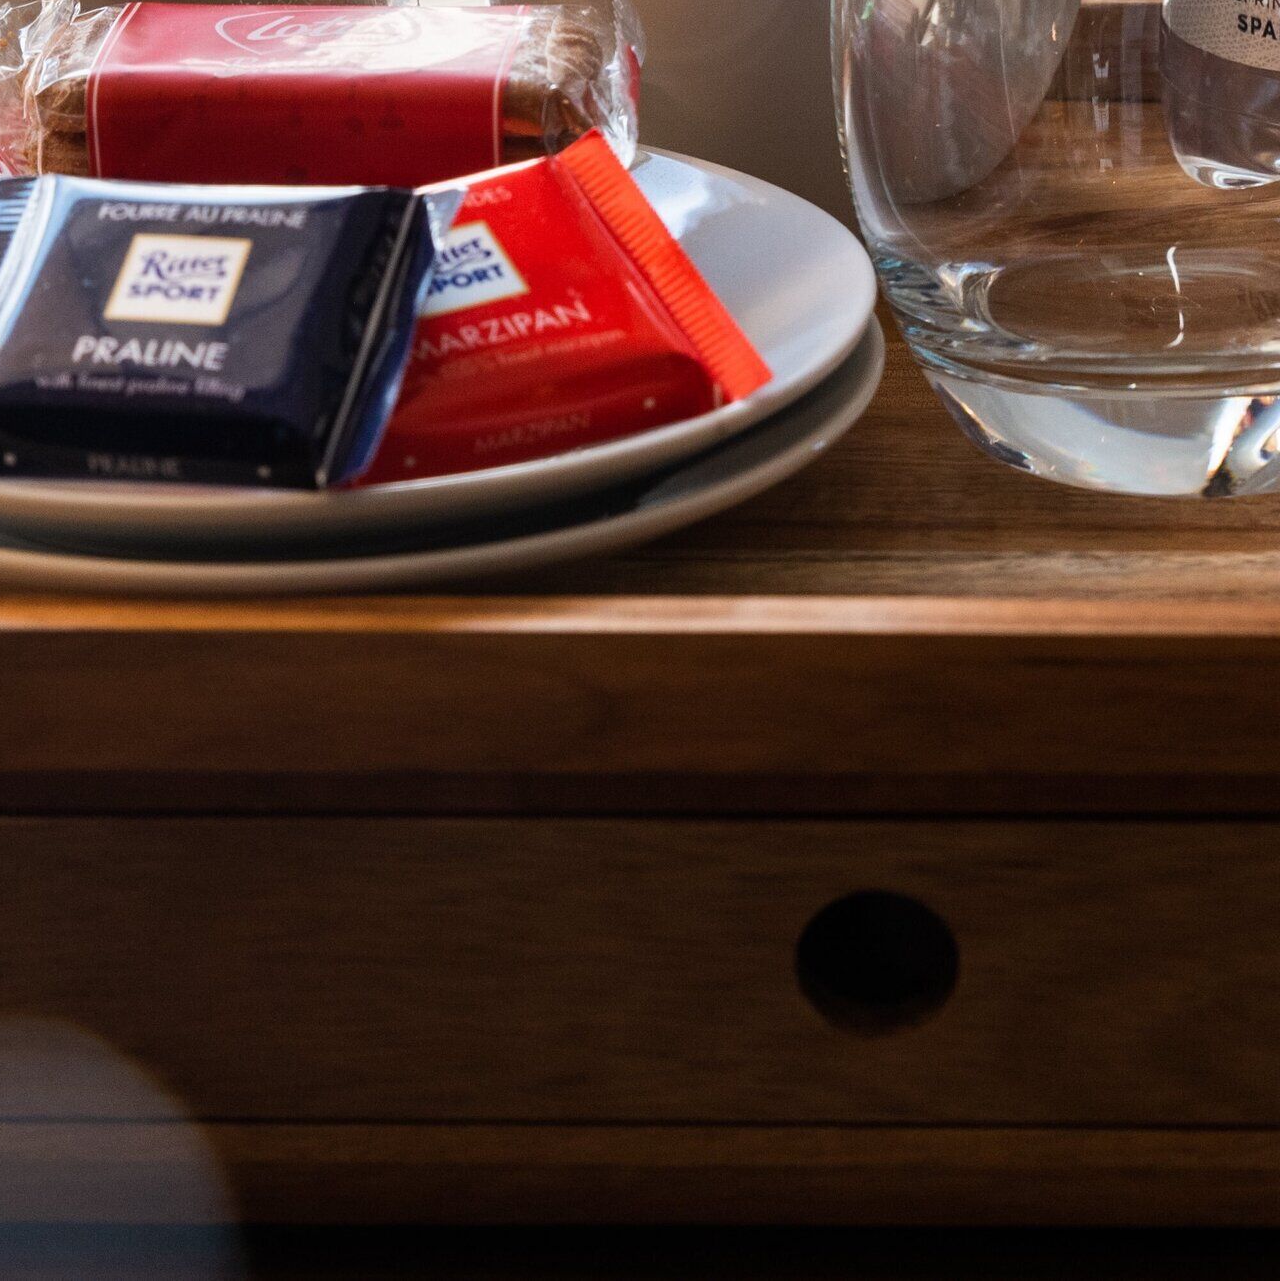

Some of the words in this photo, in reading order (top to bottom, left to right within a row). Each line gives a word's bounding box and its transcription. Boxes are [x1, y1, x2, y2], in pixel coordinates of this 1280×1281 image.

[140, 249, 228, 280] Ritter
[128, 283, 220, 301] SPORT
[72, 334, 230, 372] PRALINE
